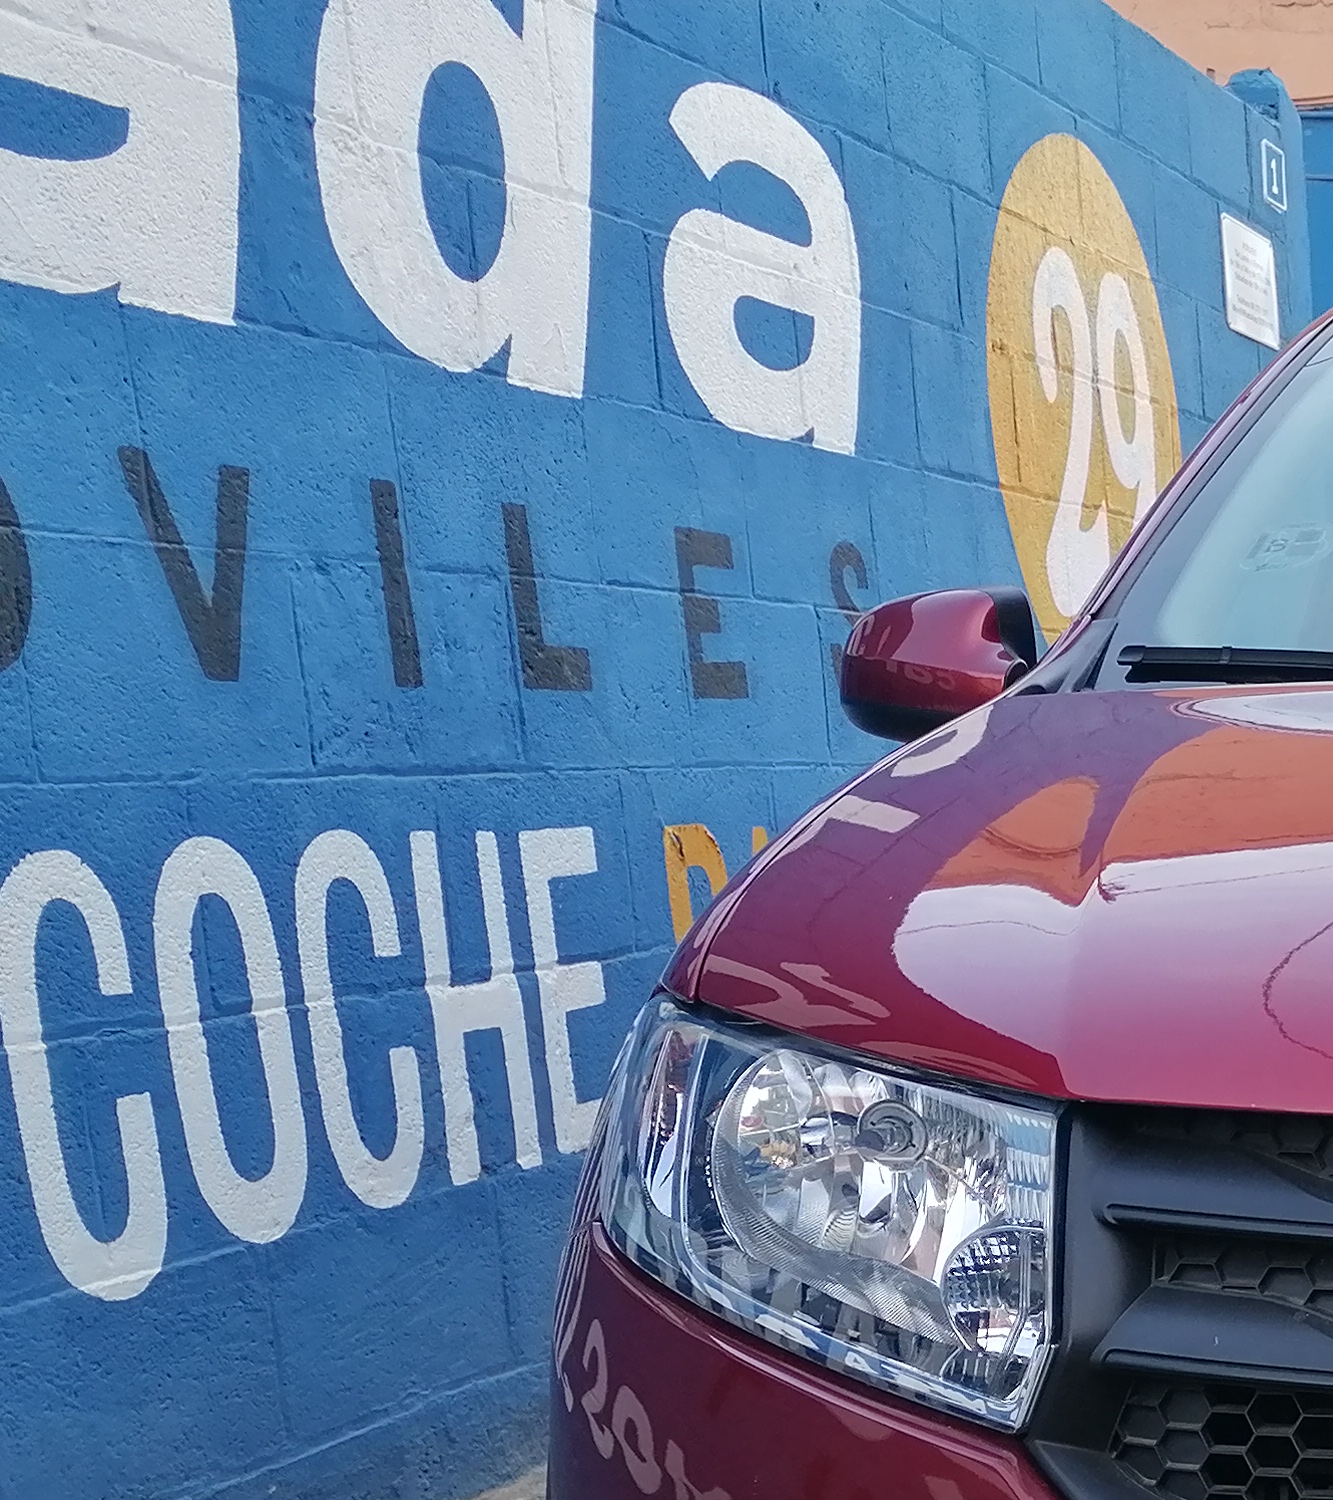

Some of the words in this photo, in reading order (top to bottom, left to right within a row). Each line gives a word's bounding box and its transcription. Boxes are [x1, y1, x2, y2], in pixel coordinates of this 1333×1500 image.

[1270, 158, 1279, 194] 1
[1033, 246, 1156, 617] 29
[1, 826, 605, 1301] COCHE
